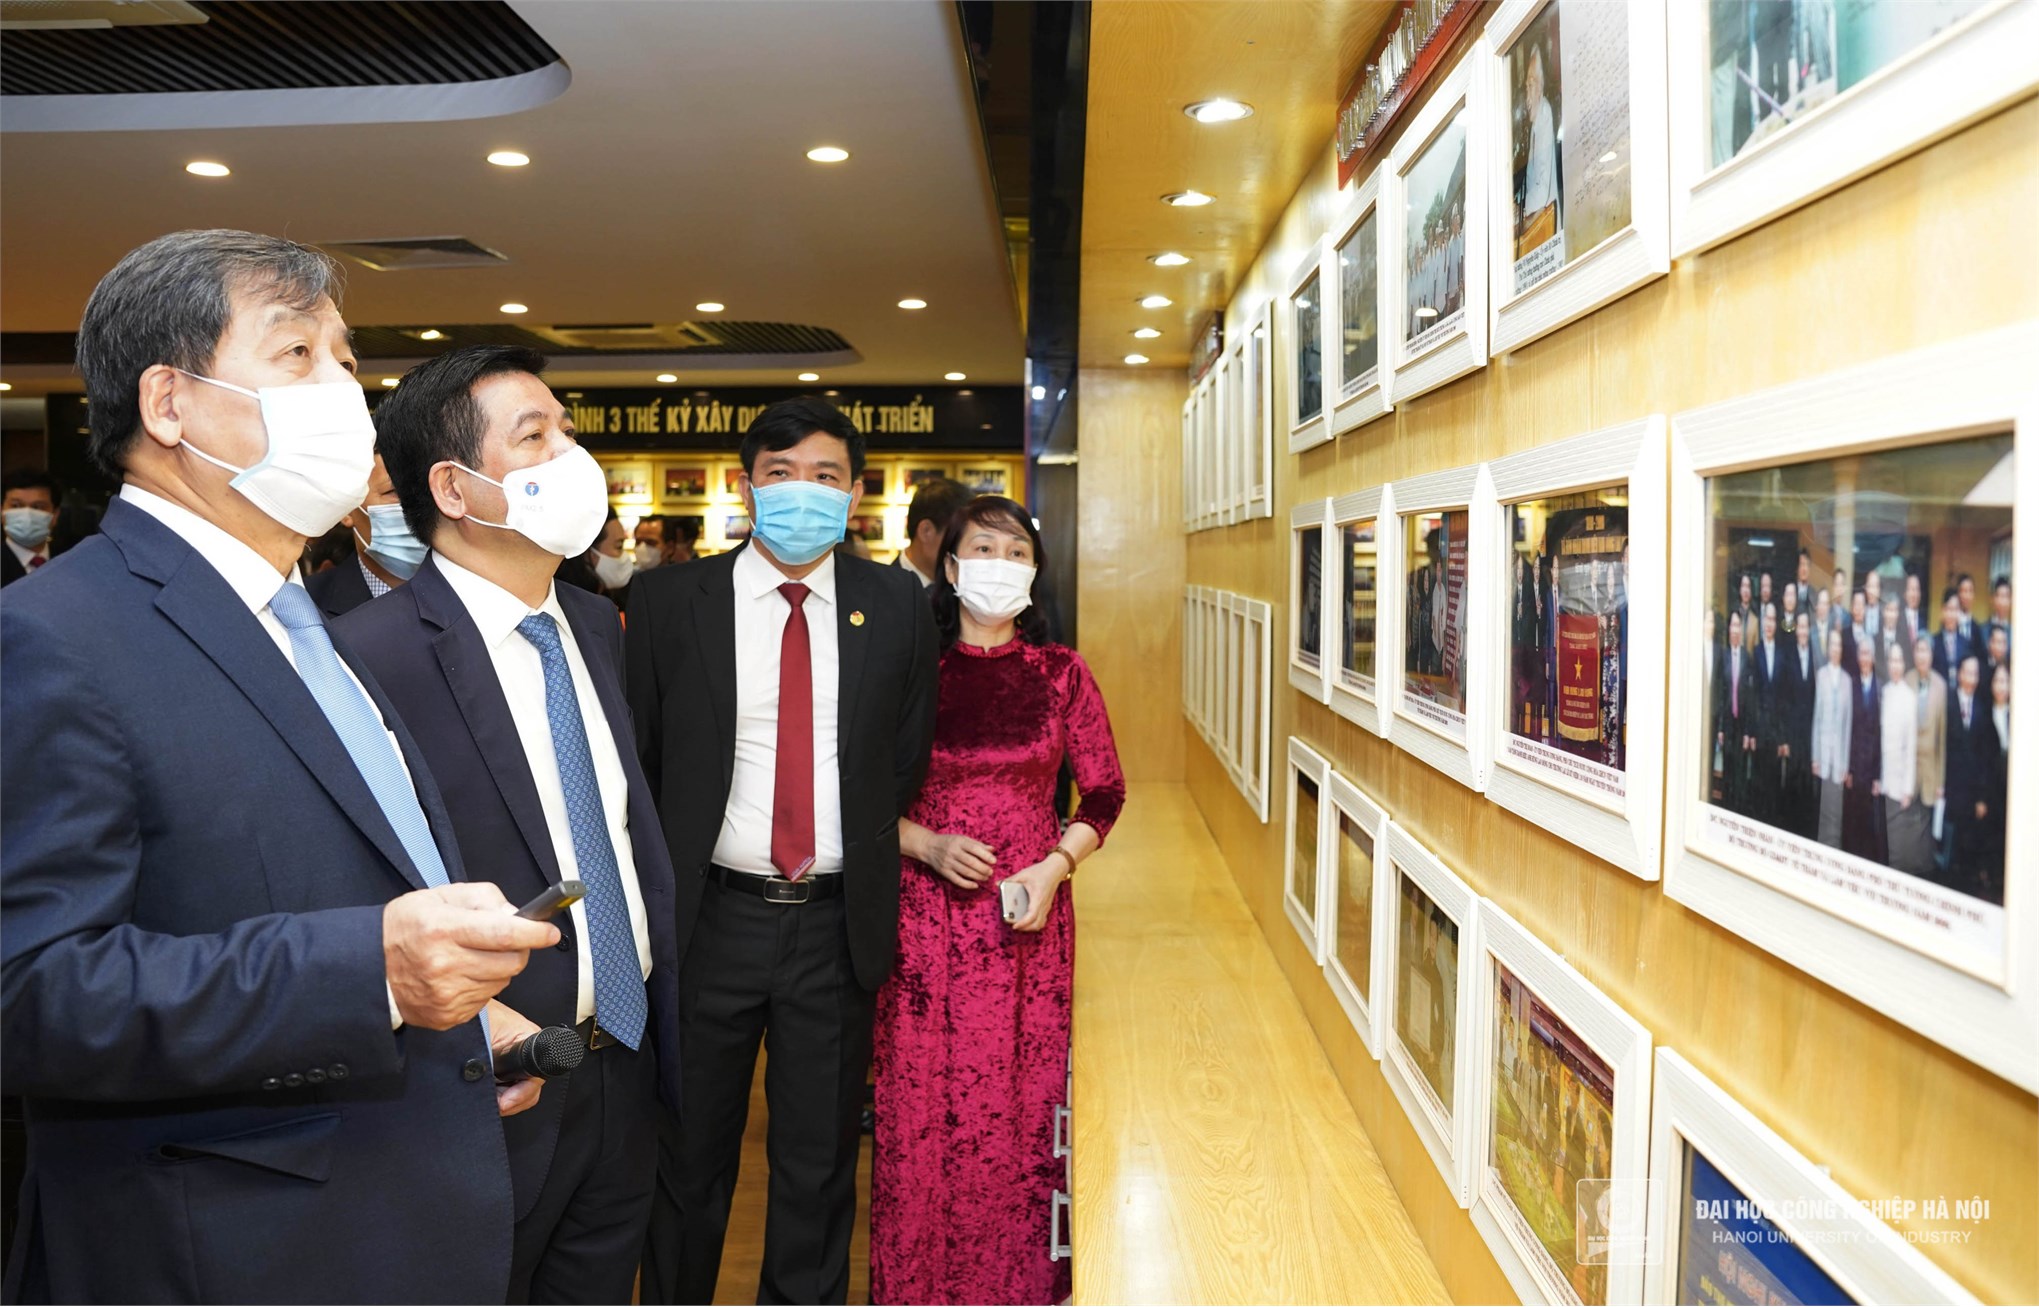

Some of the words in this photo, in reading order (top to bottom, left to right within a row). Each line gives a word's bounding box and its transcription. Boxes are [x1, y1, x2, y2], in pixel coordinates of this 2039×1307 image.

[567, 401, 605, 433] ÌNH
[608, 407, 621, 433] 3
[626, 398, 660, 433] THẾ
[666, 398, 691, 433] KỶ
[696, 400, 733, 433] XÂY
[878, 395, 933, 433] TRIỂN
